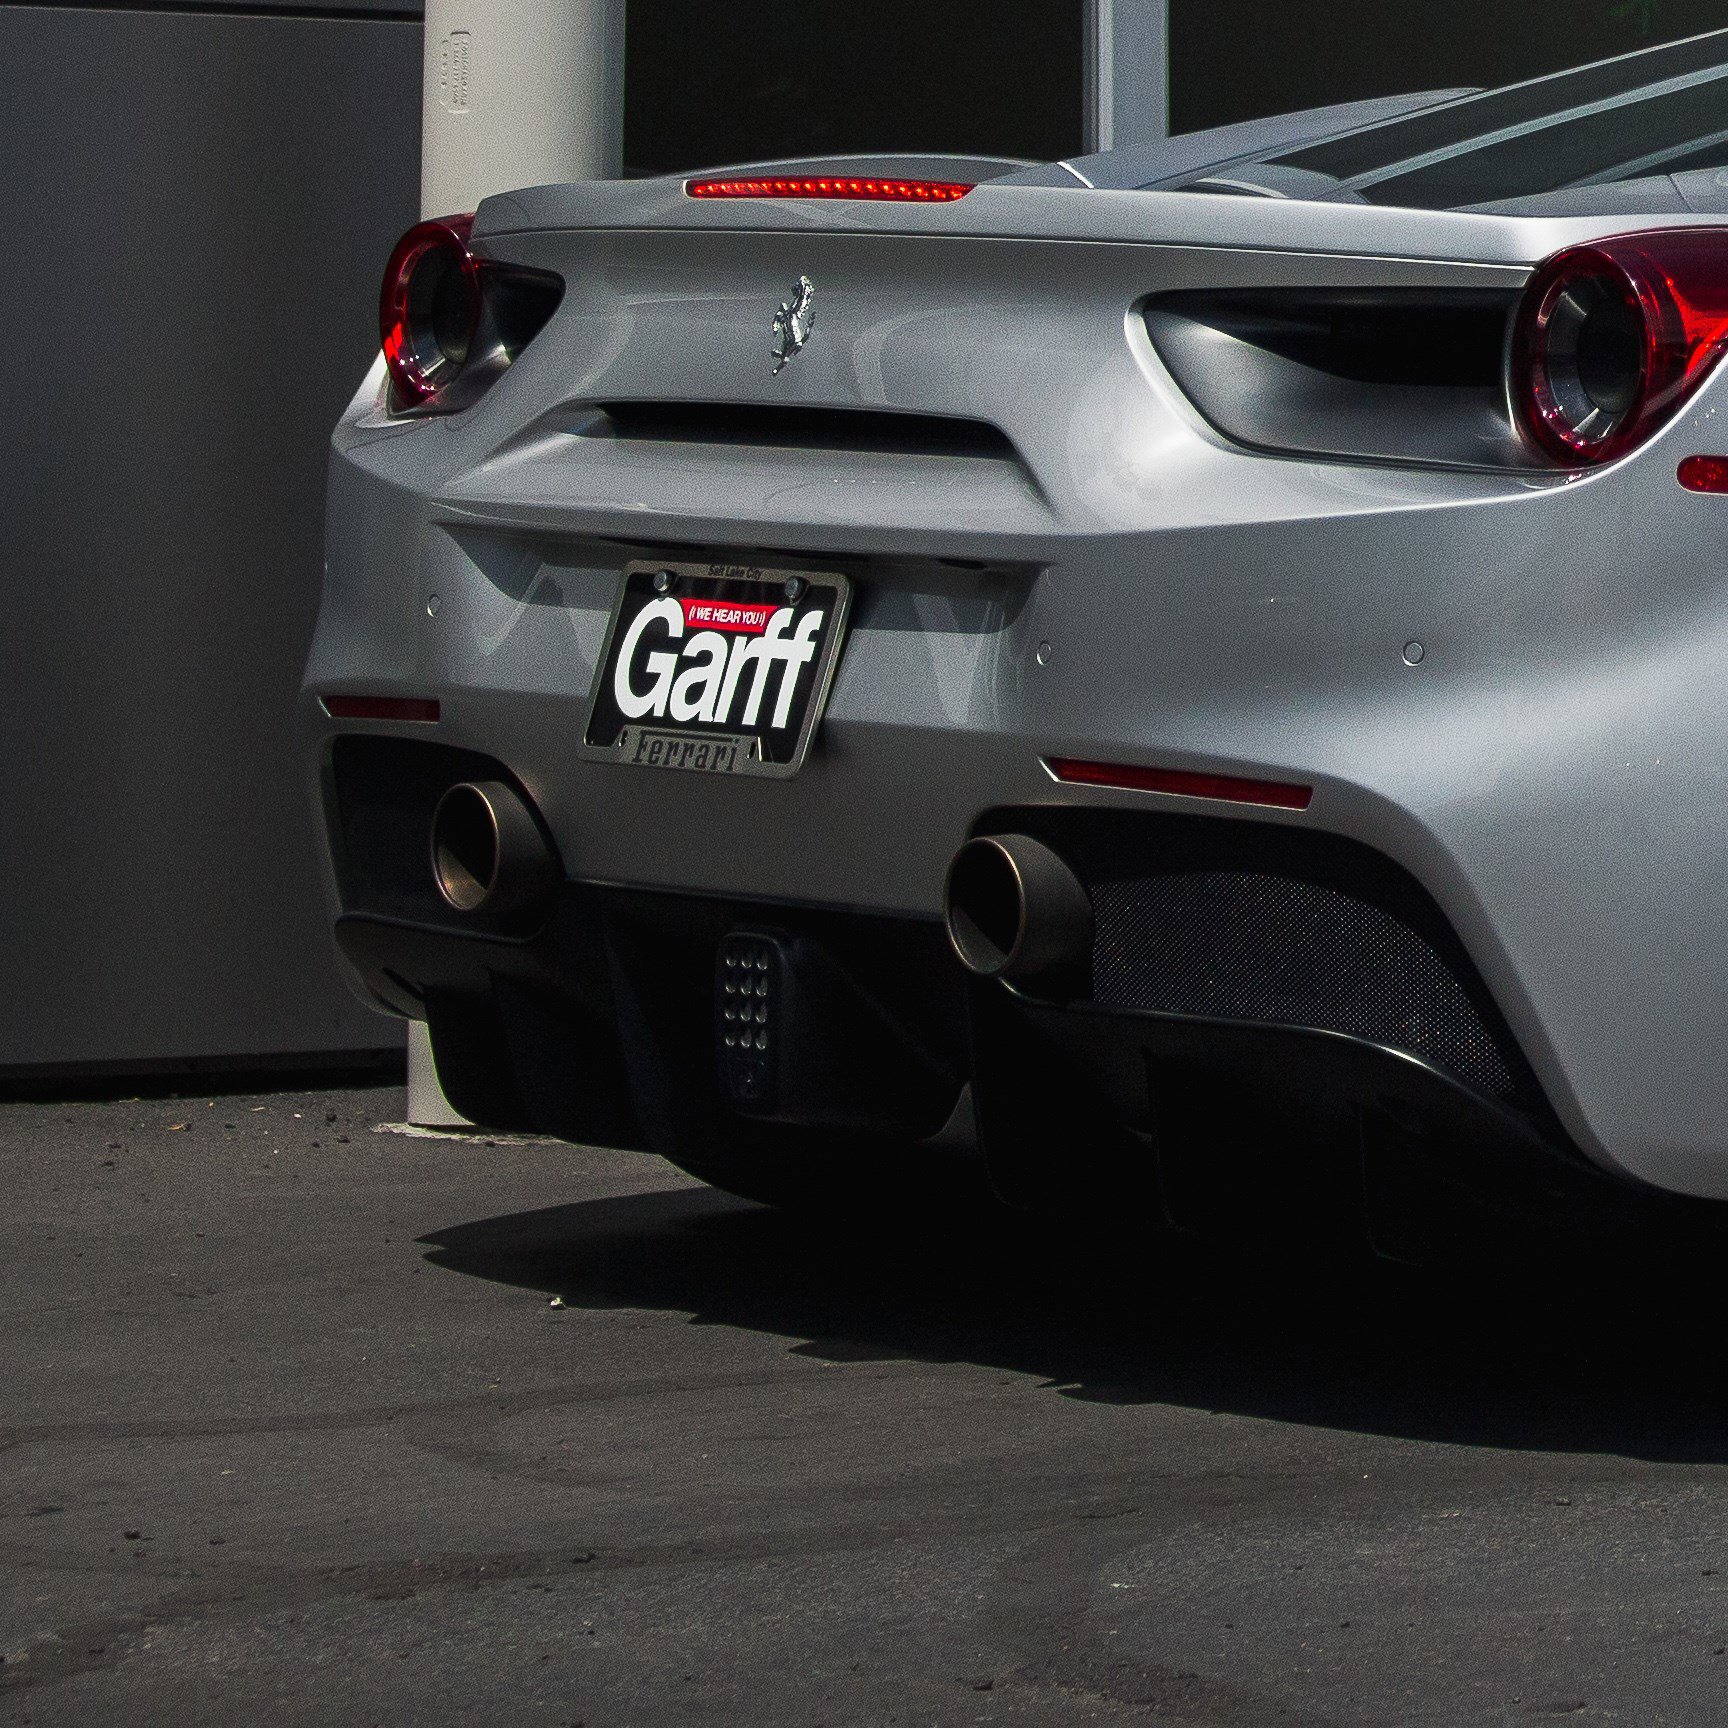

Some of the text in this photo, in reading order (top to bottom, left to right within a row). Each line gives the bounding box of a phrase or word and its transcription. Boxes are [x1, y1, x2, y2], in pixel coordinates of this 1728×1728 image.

[747, 566, 761, 581] City
[696, 607, 759, 625] WE HEAR YOU
[614, 597, 824, 729] Garff
[632, 730, 740, 771] Ferrari
